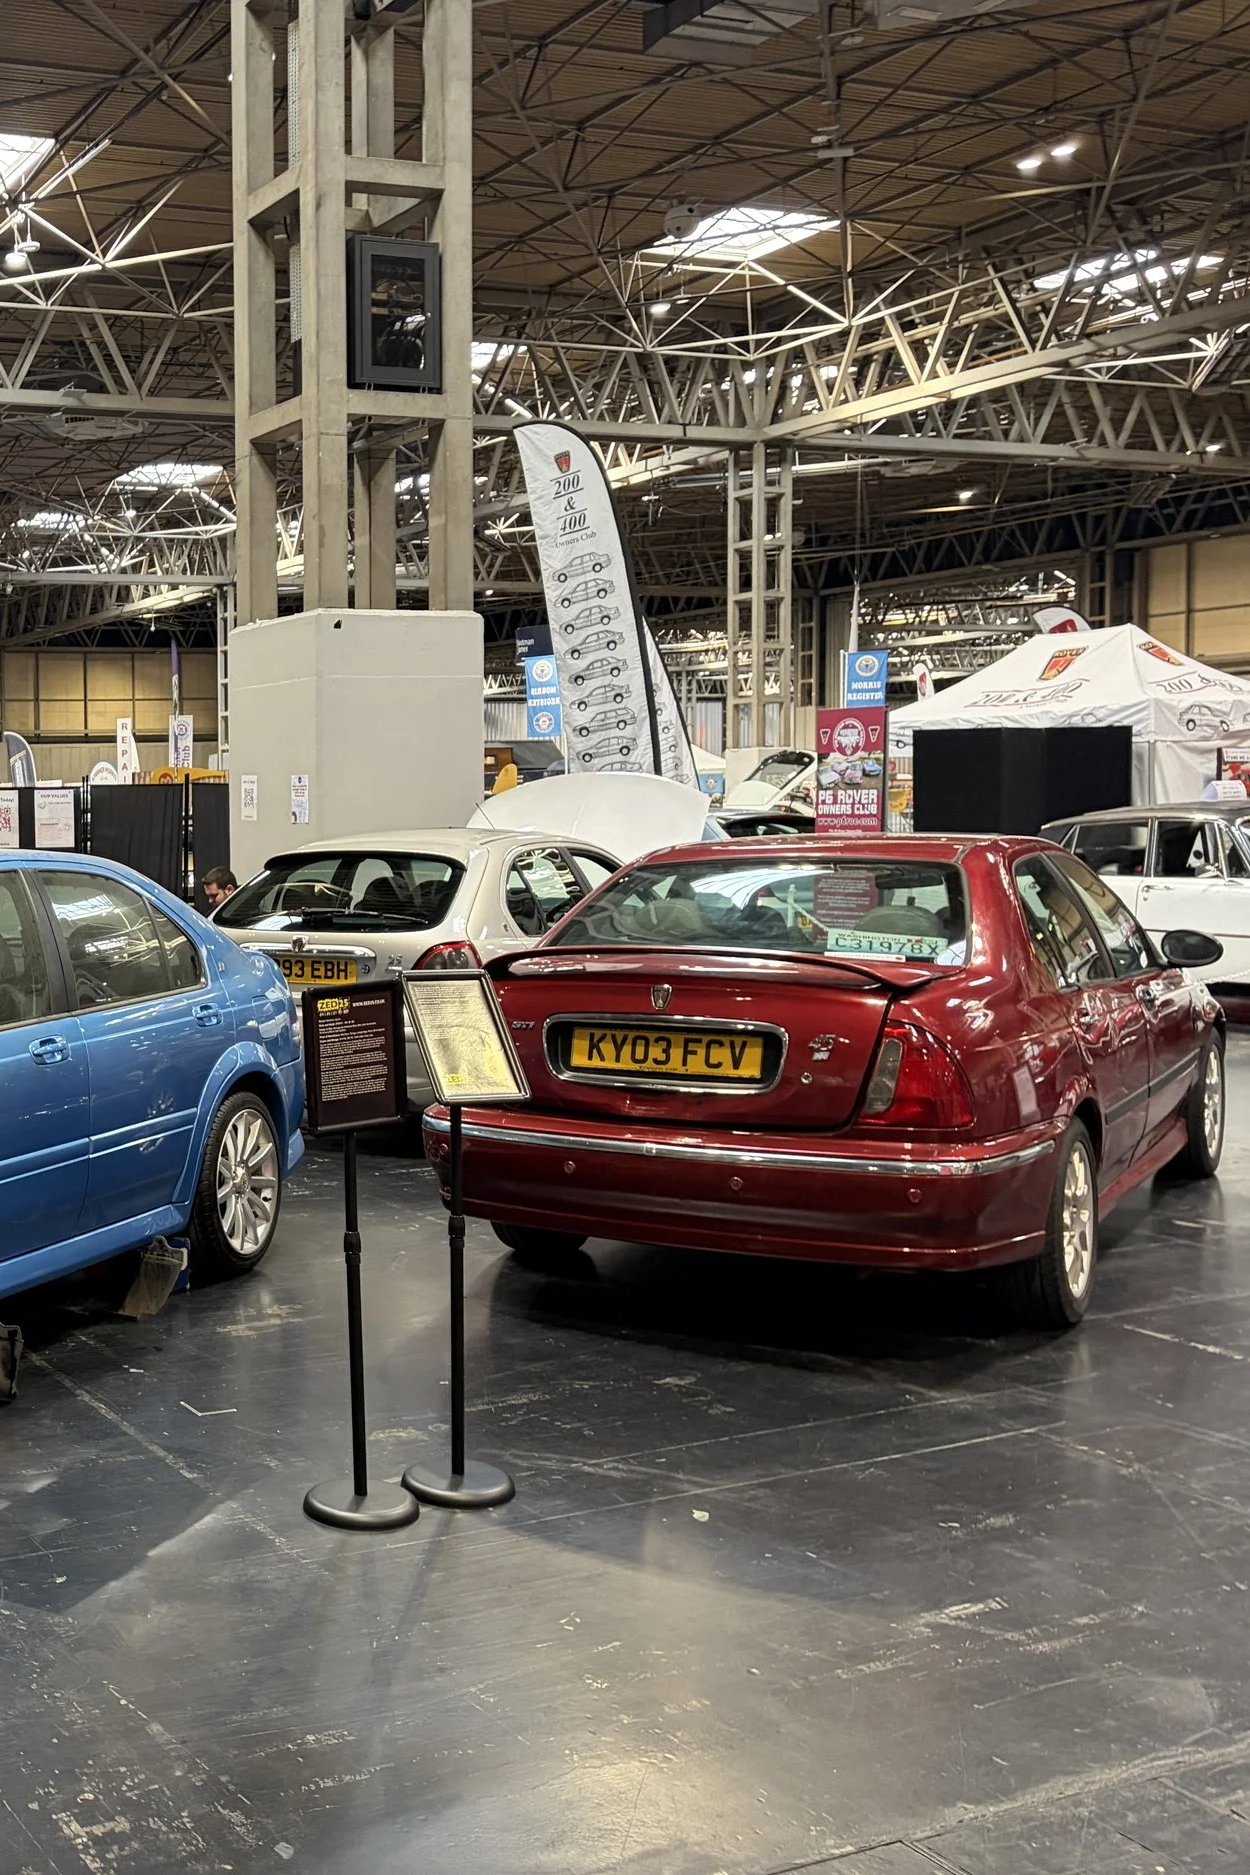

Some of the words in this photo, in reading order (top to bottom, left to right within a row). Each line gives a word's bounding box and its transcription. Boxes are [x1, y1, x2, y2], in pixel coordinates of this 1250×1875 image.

[554, 474, 580, 495] 200
[564, 496, 576, 512] &
[560, 512, 586, 532] 400
[555, 537, 580, 548] Owners
[580, 531, 597, 541] Club
[851, 680, 882, 689] MORRIS
[847, 691, 883, 700] REGISTER
[819, 790, 833, 803] P6
[838, 789, 878, 803] ROVER
[818, 804, 852, 815] OWNERS
[854, 804, 878, 814] CLUB
[835, 937, 939, 956] C31978X
[311, 960, 348, 979] EBH
[587, 1032, 671, 1066] KY03
[682, 1035, 748, 1070] FCV
